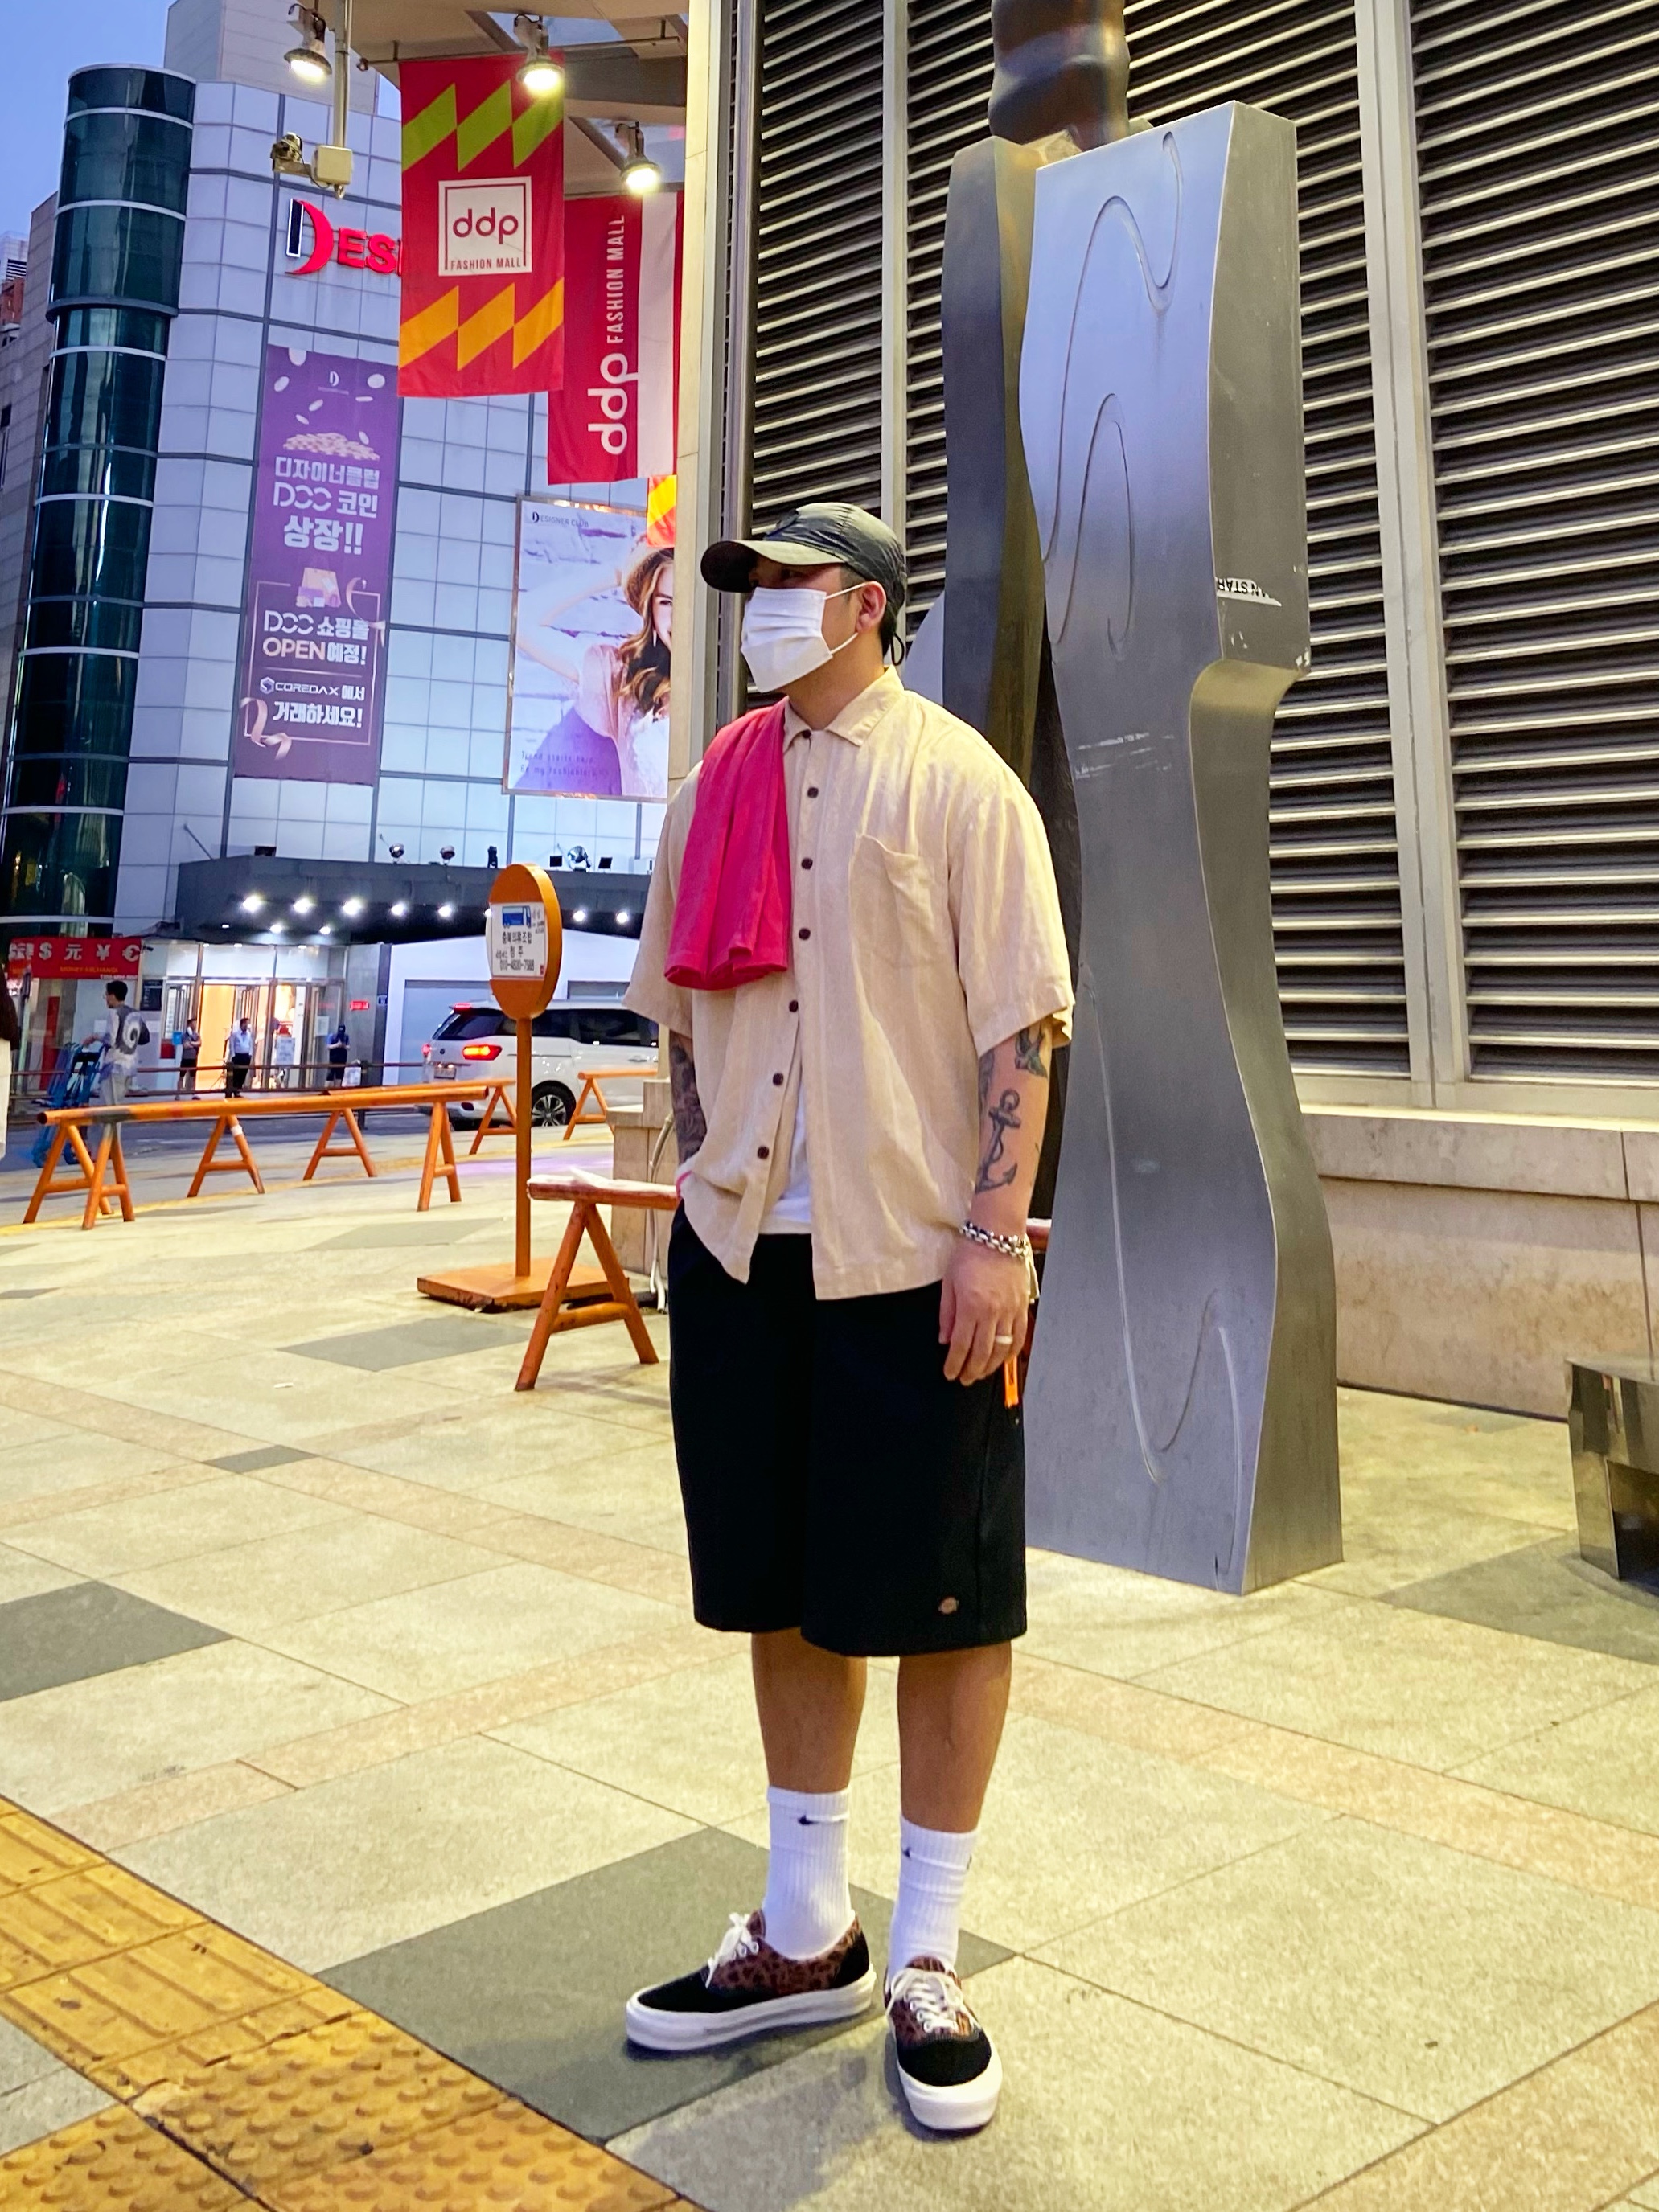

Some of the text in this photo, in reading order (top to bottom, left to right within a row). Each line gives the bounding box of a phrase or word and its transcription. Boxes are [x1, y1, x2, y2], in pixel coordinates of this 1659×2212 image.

[453, 207, 519, 244] ddp
[450, 257, 520, 270] FASHION MALL
[587, 215, 639, 455] ddp FASHION MALL
[275, 456, 380, 490] 디자이너클럽
[336, 490, 378, 519] 코인
[284, 515, 363, 555] 상장!!
[316, 616, 369, 641] 쇼핑몰
[275, 682, 365, 701] COREDAX 에서
[273, 701, 363, 728] 거래하세요!
